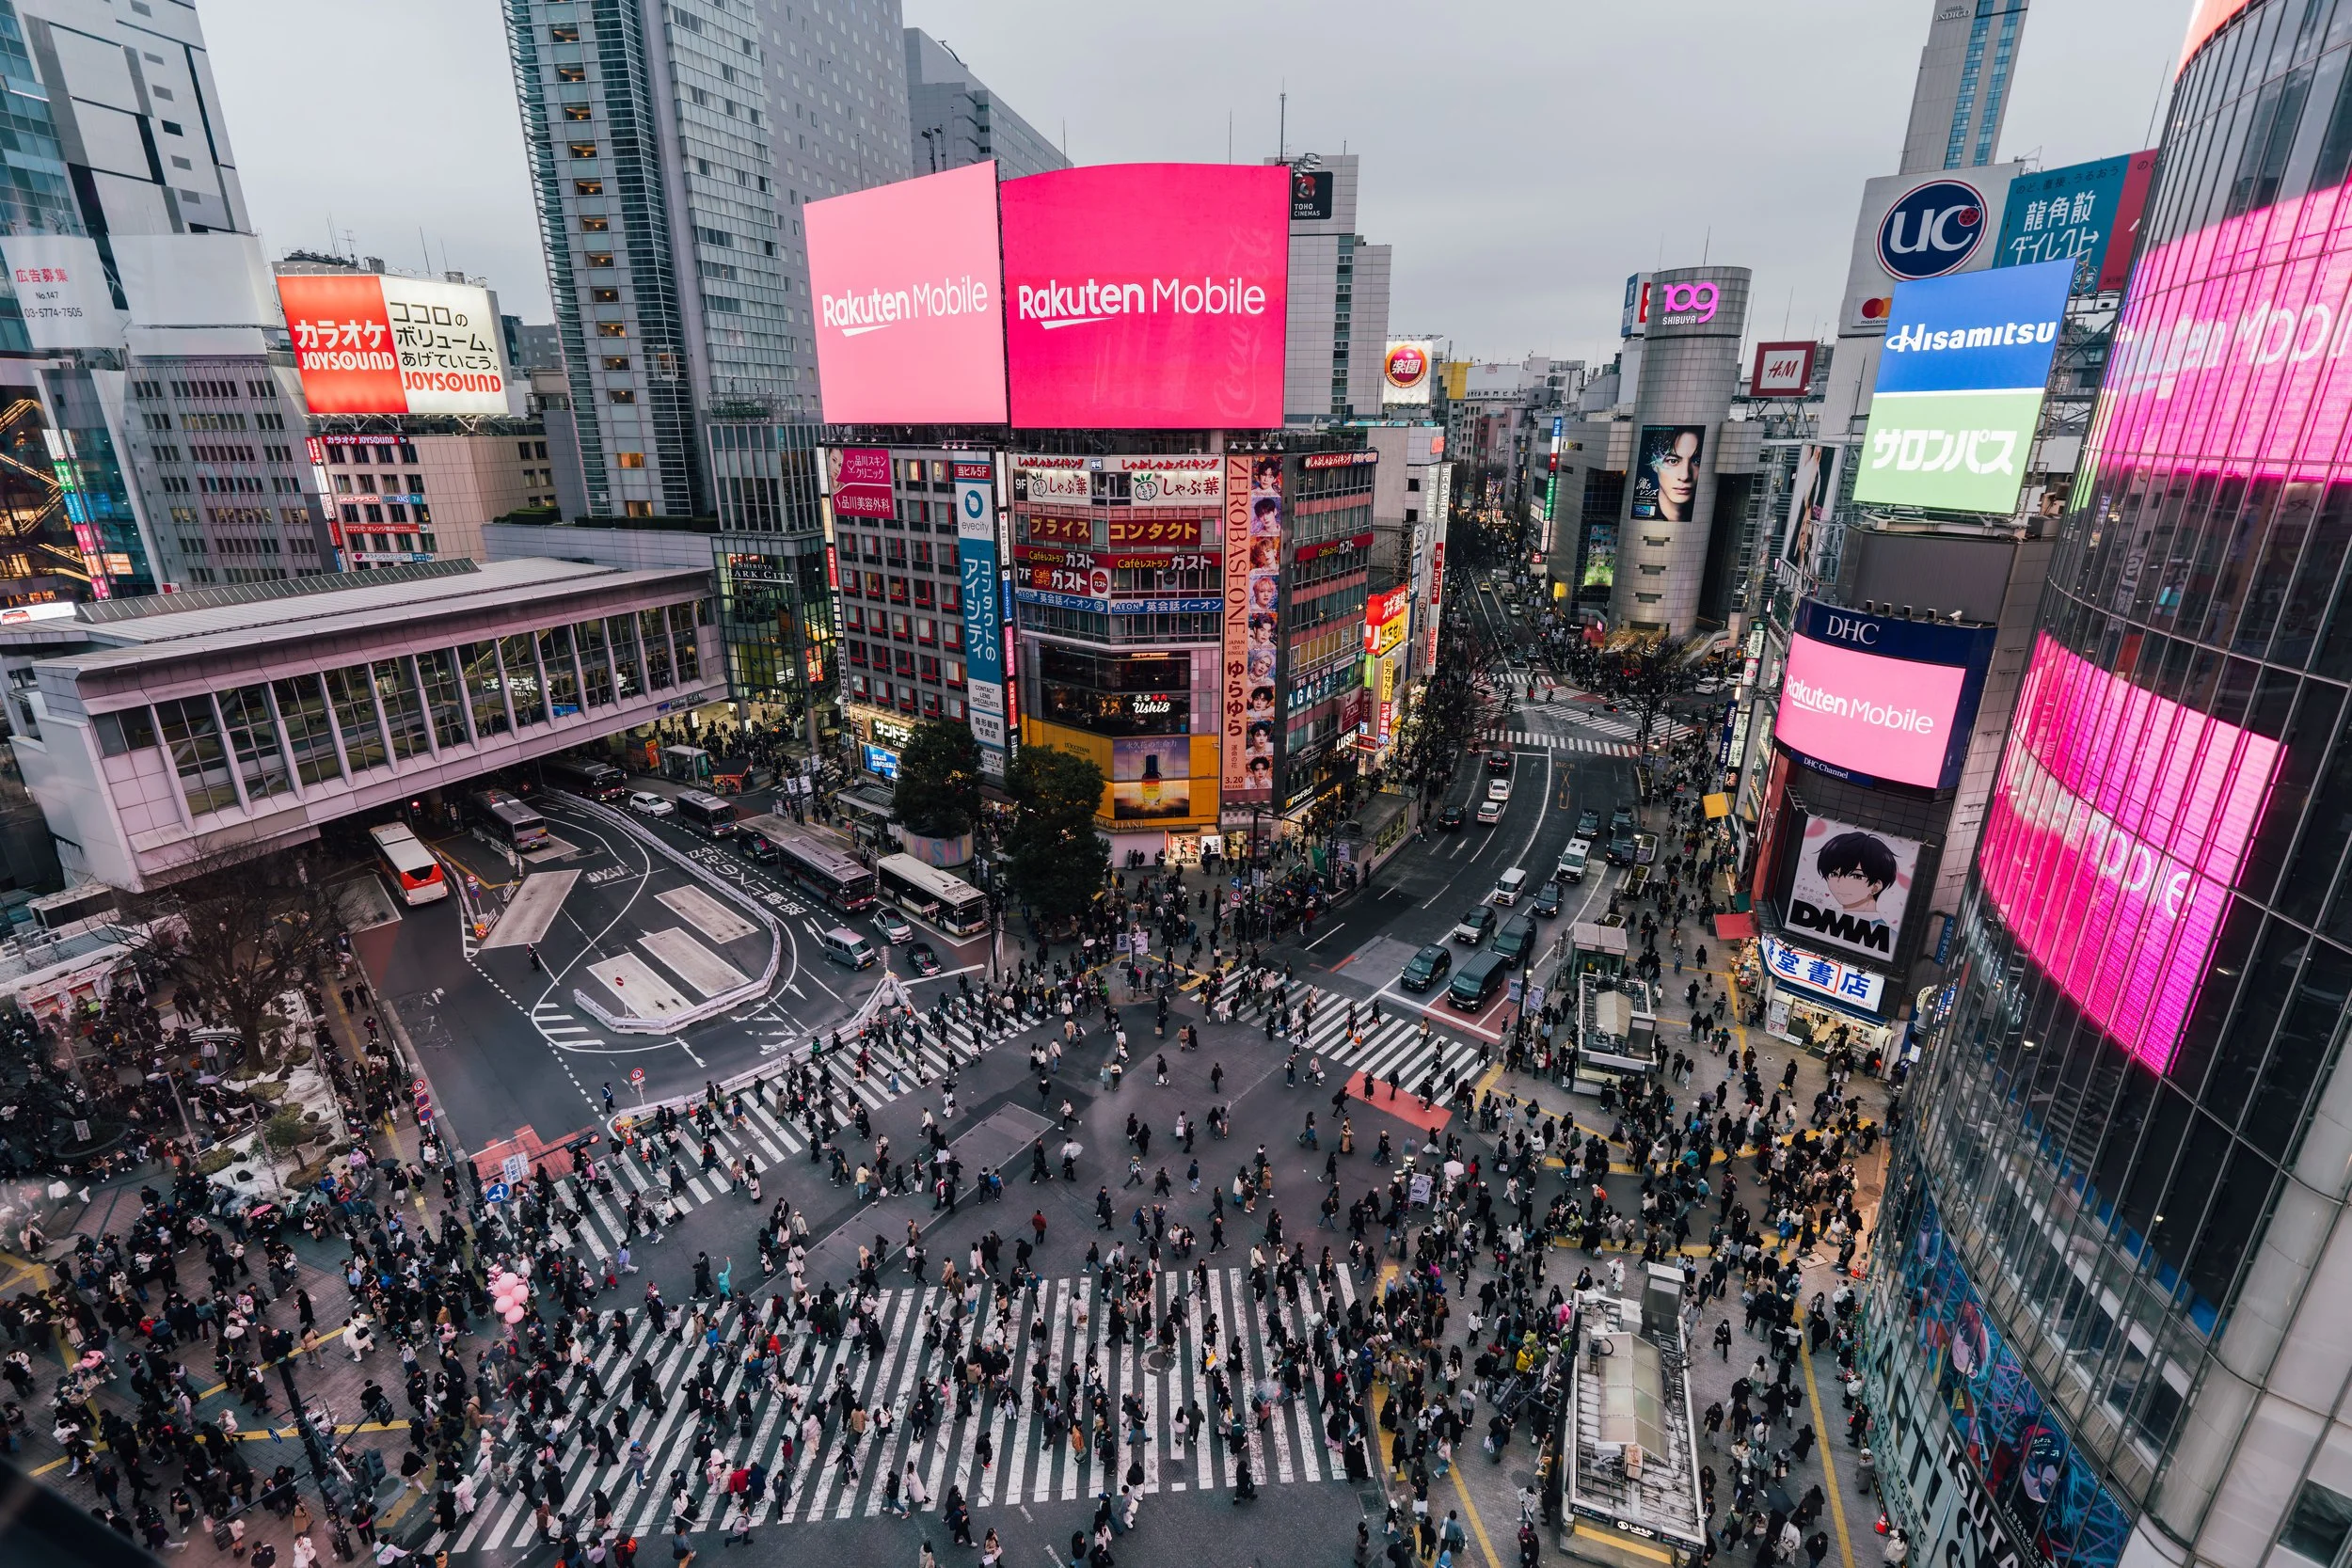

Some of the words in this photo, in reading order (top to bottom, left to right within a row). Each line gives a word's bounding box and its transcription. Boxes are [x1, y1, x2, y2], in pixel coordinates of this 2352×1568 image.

[2024, 190, 2096, 232] 龍角散
[1889, 204, 1974, 254] UC
[16, 268, 68, 282] 広告募集
[822, 286, 910, 328] Rakuten
[913, 275, 988, 317] Mobile
[1019, 279, 1145, 320] Rakuten
[1152, 277, 1265, 314] Mobile
[1663, 282, 1720, 324] 109
[24, 308, 83, 318] 03-5774-7505
[389, 301, 469, 326] ココロの
[1662, 315, 1696, 325] SHIBUYA
[294, 320, 386, 349] カラオケ
[396, 326, 493, 353] ボリューム、
[1886, 321, 2058, 352] Hisamitsu
[302, 351, 395, 371] JOYSOUND
[401, 351, 498, 371] あげていこう。
[1392, 358, 1421, 373] 楽園
[1767, 361, 1799, 378] H&M
[405, 371, 501, 392] JOYSOUND
[854, 455, 886, 467] 品川スキン
[1018, 457, 1084, 468] しゃぶしゃぶバイキング
[1872, 428, 2017, 477] サロンパス
[855, 468, 884, 480] クリニック
[958, 466, 987, 477] 当ビル5F
[1121, 458, 1219, 470] しゃぶしゃぶバイキング
[1016, 479, 1026, 490] 9F
[1049, 476, 1088, 496] しゃぶ葉
[1163, 476, 1219, 496] しゃぶ葉
[842, 496, 891, 513] 品川美容外科
[1439, 483, 1449, 518] CAMERA
[961, 522, 989, 534] eyecity
[1031, 518, 1090, 539] プライス
[1109, 522, 1198, 540] コンタクト
[1228, 459, 1248, 636] ZEROBASEONE
[1339, 540, 1354, 554] ガスト
[1066, 552, 1095, 569] ガスト
[1171, 553, 1212, 571] ガスト
[763, 570, 793, 580] CITY
[1018, 567, 1031, 580] 7F
[1035, 569, 1050, 578] Café
[1051, 570, 1087, 591] ガスト
[1018, 590, 1034, 598] AEON
[1040, 593, 1091, 609] 英会話イーオン
[963, 558, 982, 658] アイシティ
[980, 560, 996, 661] コンタクトの
[1114, 602, 1141, 611] AEON
[1146, 601, 1221, 612] 英会話イーオン
[1826, 615, 1880, 644] DHC
[975, 685, 994, 693] CONTACT
[1227, 660, 1244, 736] ゆらゆら
[973, 697, 999, 707] SPECIALISTS
[1132, 702, 1170, 714] Ushi8
[1786, 673, 1848, 717] Rakuten
[1850, 698, 1933, 734] Mobile
[1727, 706, 1737, 728] MIZUHO
[1336, 730, 1356, 752] LUSH
[1804, 757, 1819, 769] DHC
[1820, 764, 1849, 779] Channel
[1225, 776, 1244, 784] 3.20
[1789, 898, 1890, 954] DMM
